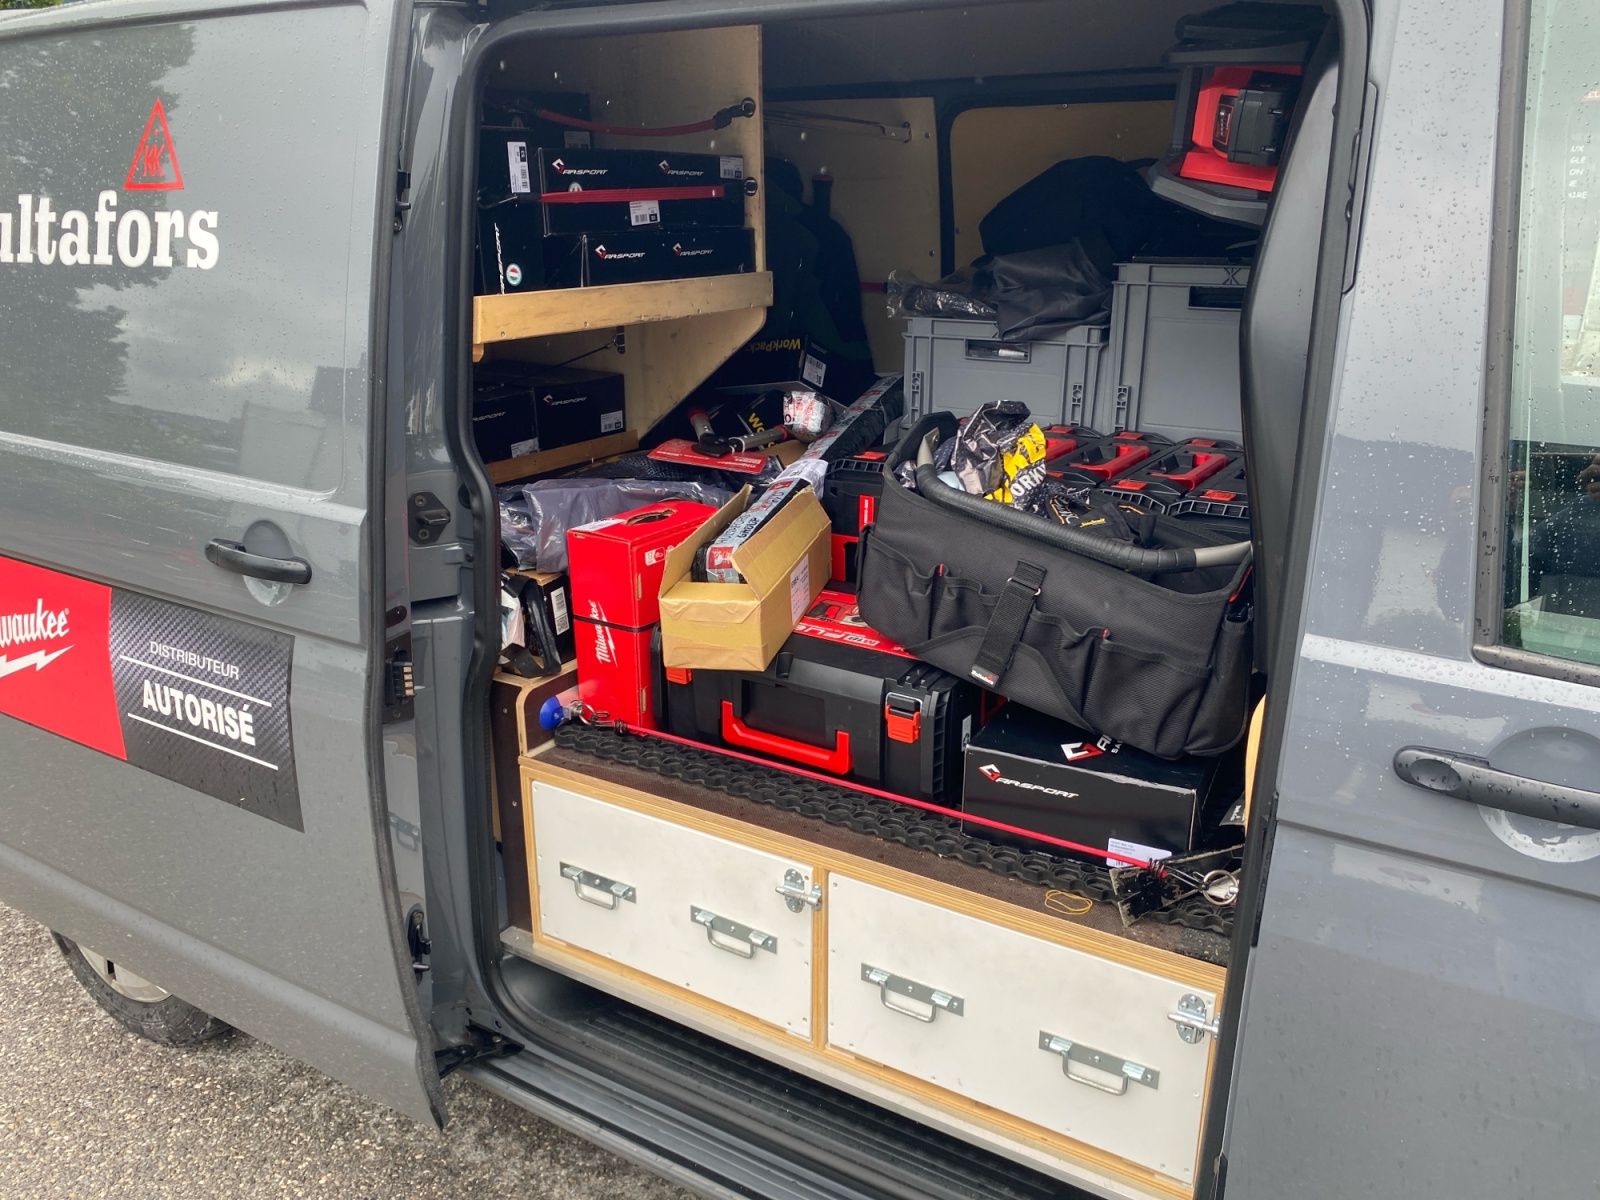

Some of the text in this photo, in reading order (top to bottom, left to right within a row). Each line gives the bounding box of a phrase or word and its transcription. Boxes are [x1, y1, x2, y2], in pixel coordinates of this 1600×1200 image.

[150, 641, 239, 680] DISTRIBUTEUR
[589, 602, 611, 664] Milwakee
[143, 679, 256, 746] AUTORISÉ
